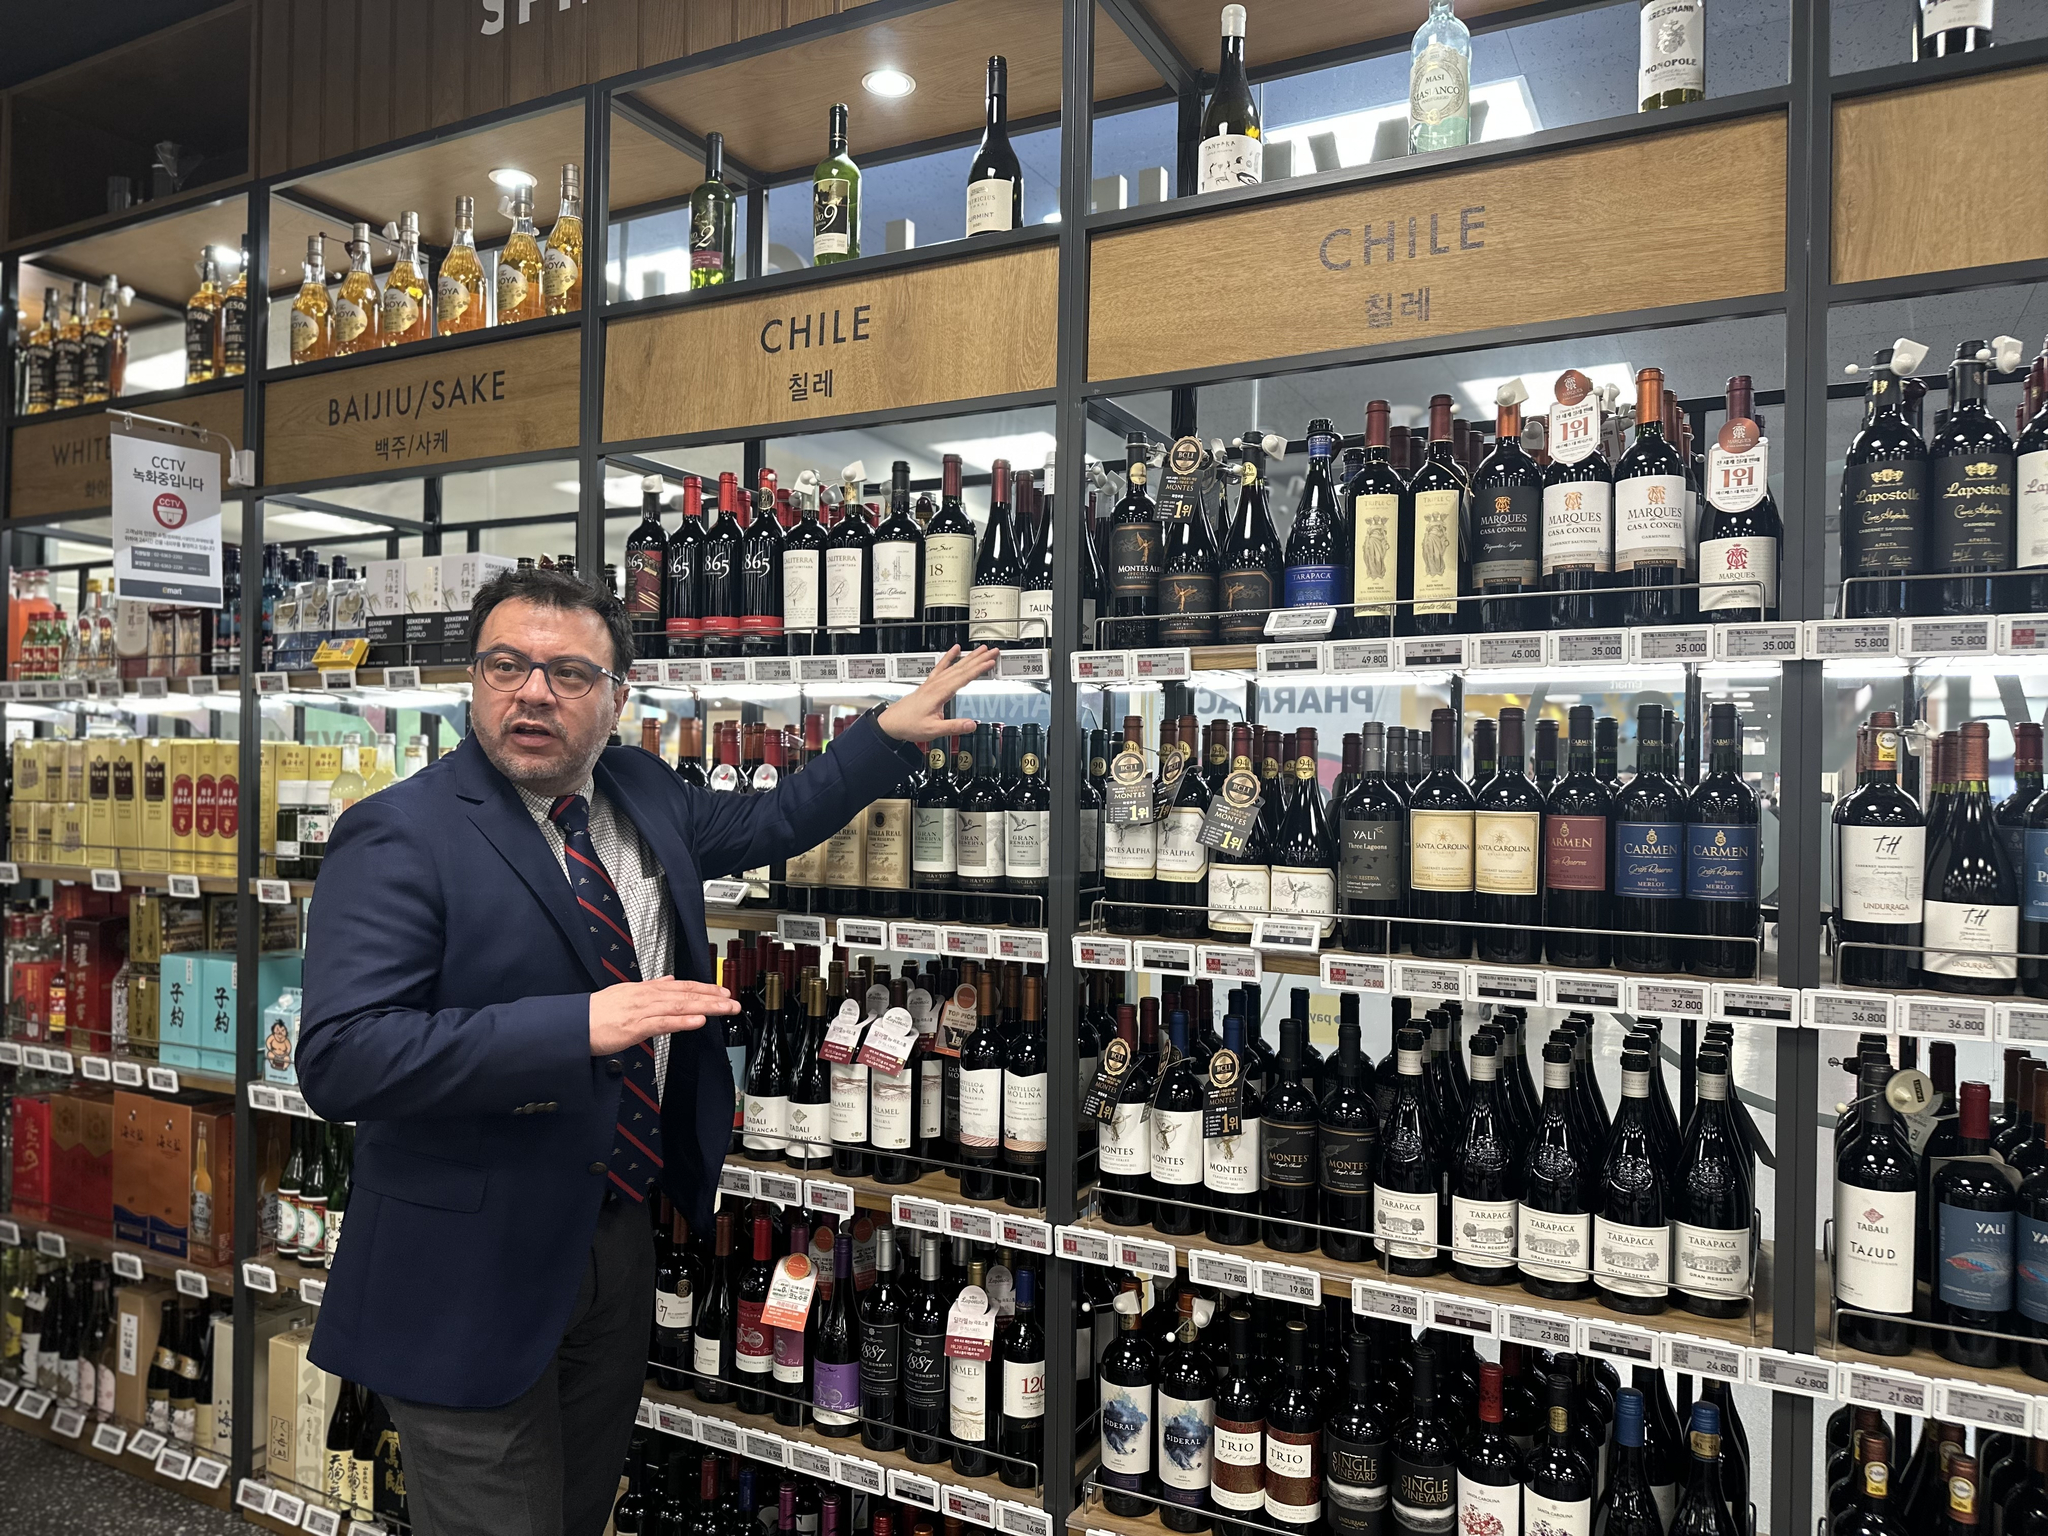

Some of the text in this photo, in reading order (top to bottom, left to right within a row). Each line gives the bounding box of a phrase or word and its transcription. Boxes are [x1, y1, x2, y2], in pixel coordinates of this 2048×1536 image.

[1644, 58, 1697, 75] MONOPOLE
[1425, 74, 1445, 84] MASI
[820, 203, 838, 231] 9
[1319, 206, 1485, 271] CHILE
[1365, 287, 1430, 329] 칠레
[760, 305, 870, 353] CHILE
[789, 369, 833, 402] 칠레
[328, 370, 506, 426] BAIJIU/SAKE
[1559, 416, 1588, 441] 1위
[375, 429, 448, 461] 백주/사케
[151, 456, 186, 472] CCTV
[133, 468, 204, 491] 녹화중입니다
[1720, 466, 1754, 488] 1위
[1854, 488, 1920, 505] Lapostolle
[1943, 481, 2012, 499] Lapostolle
[159, 498, 181, 507] CCTV
[1174, 500, 1193, 518] 1위
[1481, 513, 1528, 526] MARQUES
[1548, 512, 1602, 526] MARQUES
[1627, 507, 1682, 520] MARQUES
[1480, 525, 1527, 534] CASA CONCHA
[1548, 526, 1601, 537] CASA CONCHA
[1627, 521, 1682, 531] CASA CONCHA
[929, 564, 944, 576] 18
[1118, 565, 1149, 573] MONTES
[1718, 572, 1756, 580] MARQUES
[162, 586, 183, 595] emart
[974, 608, 988, 619] 25
[931, 752, 942, 762] 92
[959, 754, 969, 764] 92
[1024, 757, 1035, 767] 90
[1129, 805, 1149, 821] 1위
[1214, 812, 1247, 826] MONTES
[1220, 831, 1243, 851] 1위
[1353, 830, 1377, 841] YALI
[1125, 846, 1151, 854] ALPHA
[1170, 848, 1195, 857] ALPHA
[1348, 842, 1388, 851] Three Lagoons
[1436, 843, 1471, 851] CAROLINA
[1493, 844, 1531, 853] CAROLINA
[1624, 843, 1678, 855] CARMEN
[1693, 846, 1749, 858] CARMEN
[1863, 903, 1909, 911] UNDURRAGA
[1952, 961, 1997, 971] UNDURRAGA
[1095, 1082, 1118, 1094] MONTES
[1208, 1097, 1236, 1105] MONTES
[1097, 1100, 1113, 1119] 1위
[1222, 1113, 1239, 1133] 1위
[1101, 1145, 1134, 1155] MONTES
[1152, 1154, 1184, 1165] MONTES
[1269, 1152, 1308, 1163] MONTES
[1209, 1162, 1248, 1174] MONTES
[1328, 1159, 1369, 1170] MONTES
[1856, 1221, 1889, 1234] TABALI
[1975, 1221, 2007, 1236] YALI
[1849, 1240, 1896, 1260] TALUD
[1545, 1257, 1572, 1265] RESERVA
[860, 1343, 886, 1362] 1887
[906, 1354, 934, 1373] 1887
[1103, 1415, 1135, 1432] SIDERAL
[1166, 1434, 1201, 1446] SIDERAL
[1219, 1438, 1254, 1453] TRIO
[1269, 1449, 1304, 1465] TRIO
[1331, 1451, 1378, 1472] SINGLE
[1332, 1465, 1378, 1482] VINEYARD
[1400, 1474, 1449, 1494] SINGLE
[1401, 1487, 1449, 1503] VINEYARD
